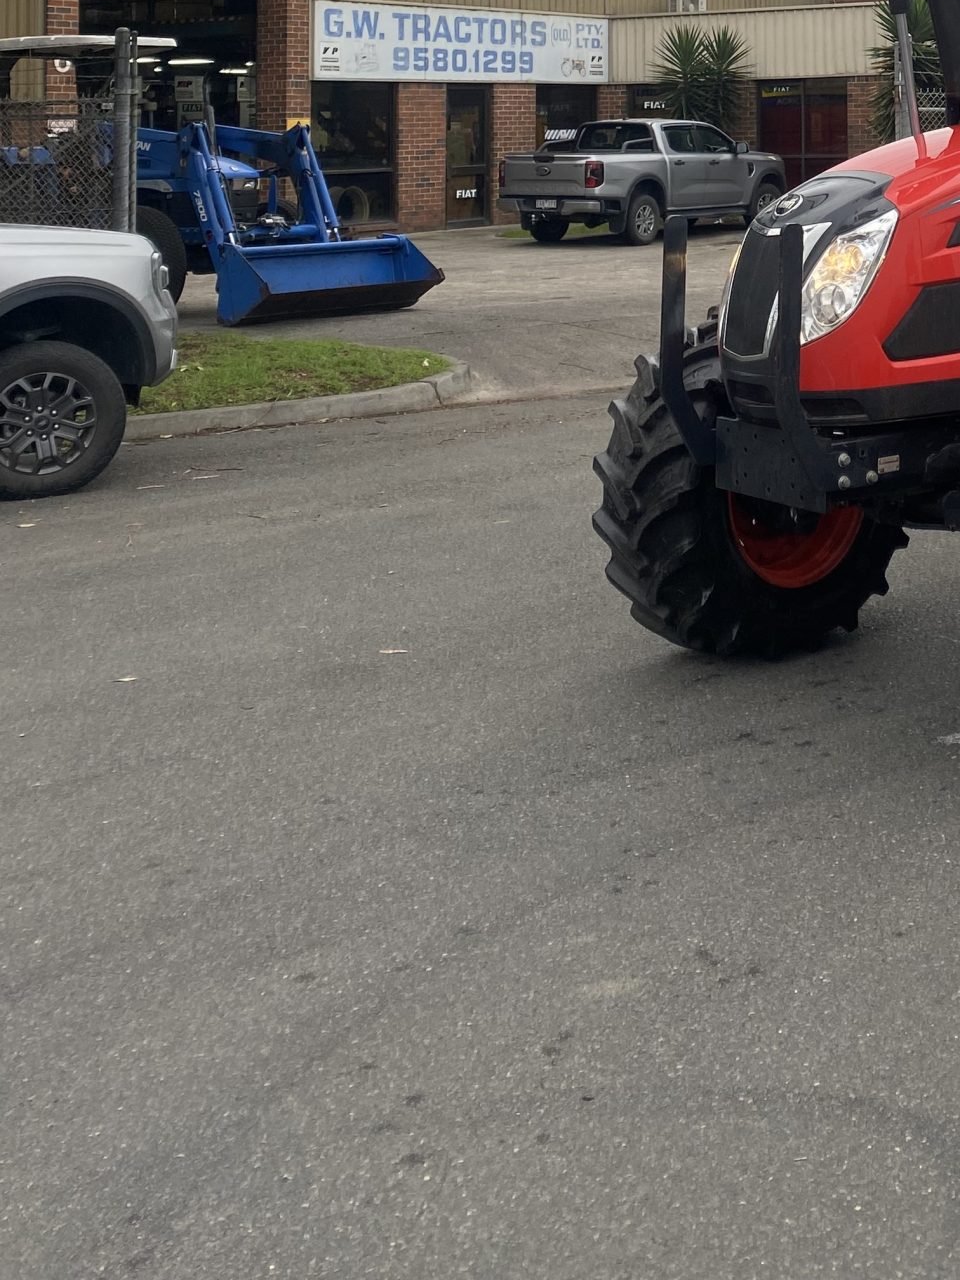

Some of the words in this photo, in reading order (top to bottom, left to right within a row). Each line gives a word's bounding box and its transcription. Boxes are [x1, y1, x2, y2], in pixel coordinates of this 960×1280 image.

[324, 8, 385, 40] G.W.
[392, 13, 547, 47] TRACTORS
[576, 23, 603, 35] PTY.
[576, 37, 603, 49] LTD.
[643, 101, 666, 109] FIAT
[456, 189, 477, 199] FIAT
